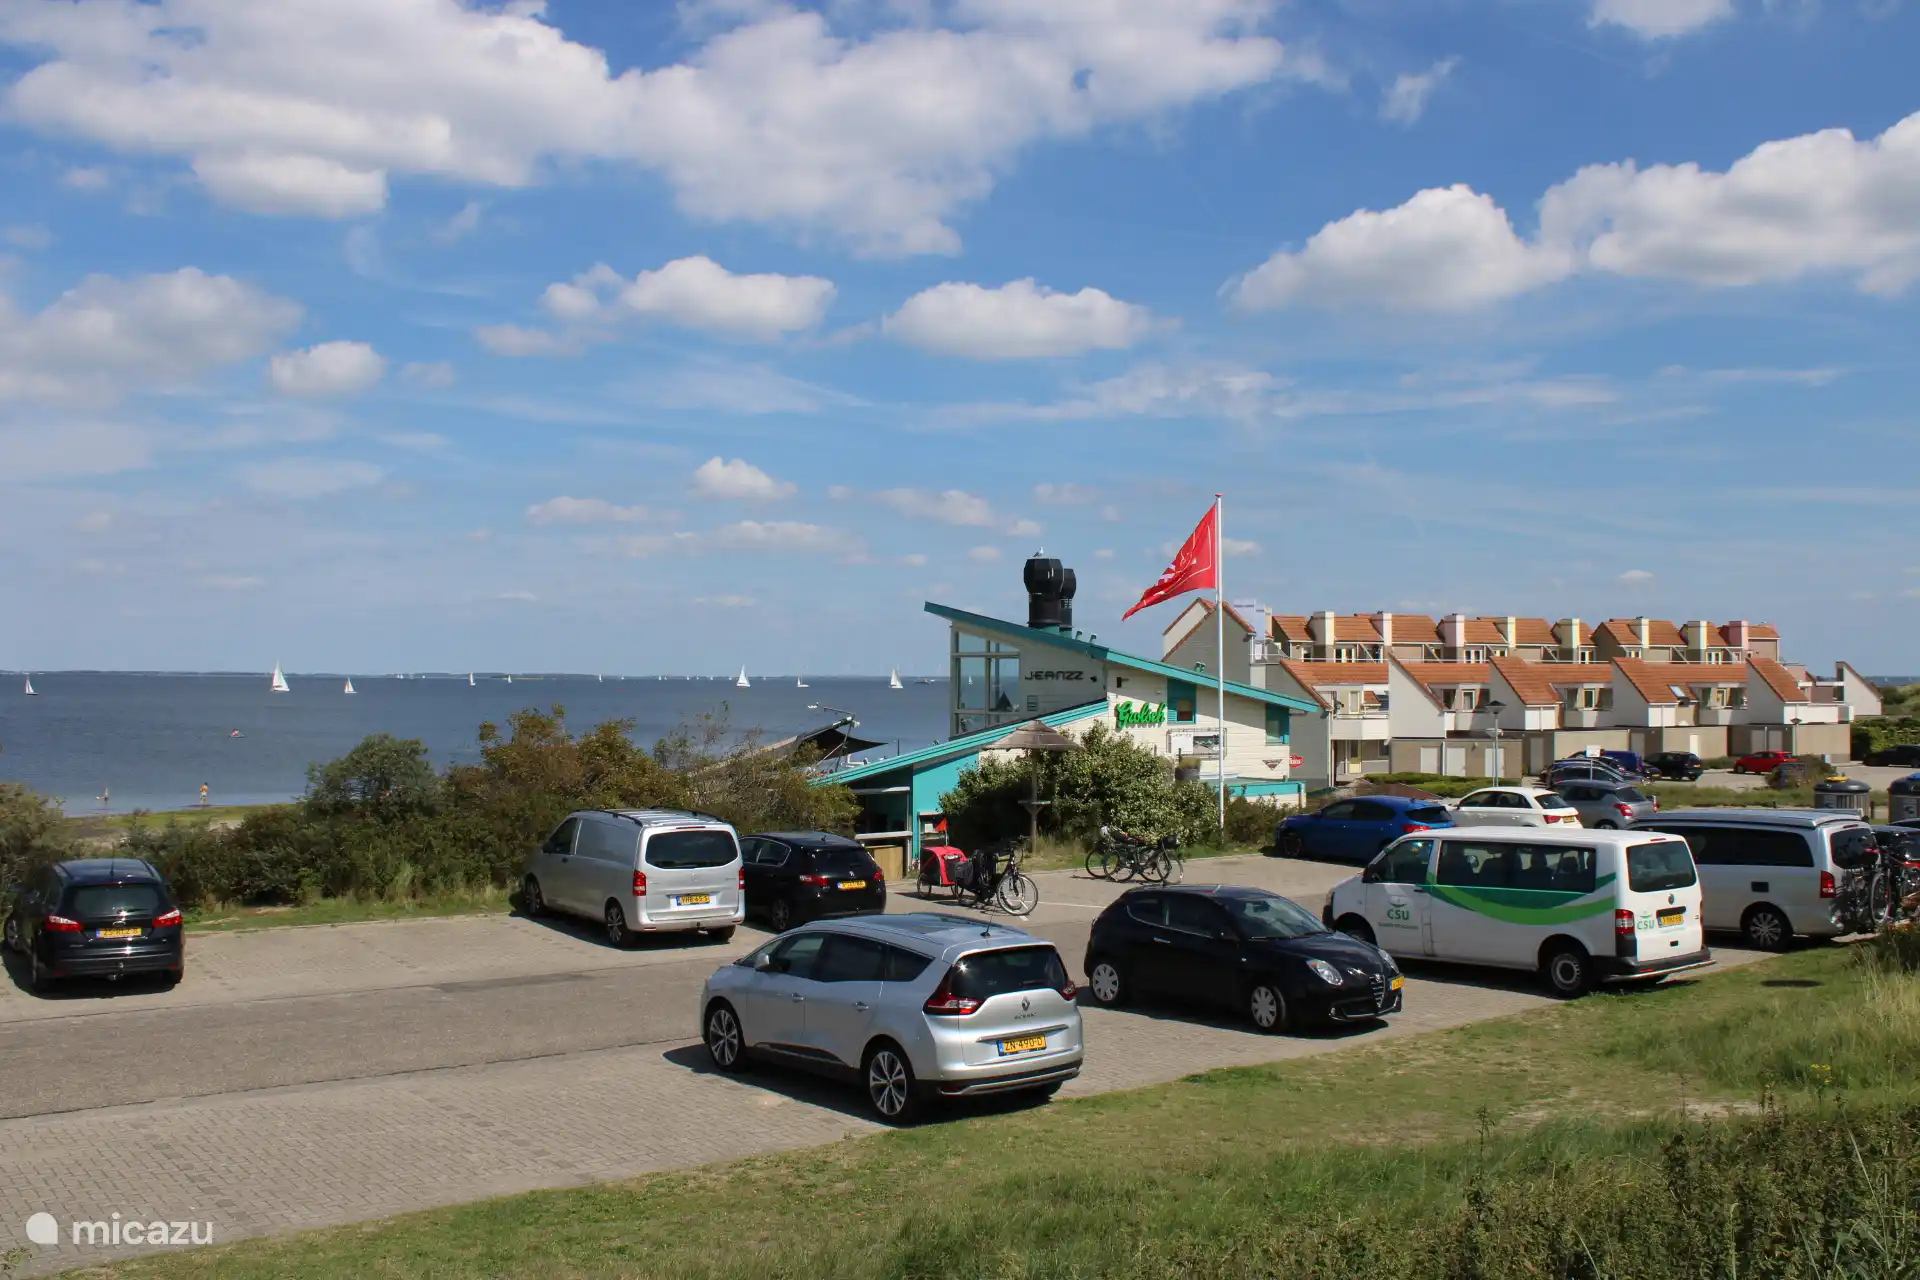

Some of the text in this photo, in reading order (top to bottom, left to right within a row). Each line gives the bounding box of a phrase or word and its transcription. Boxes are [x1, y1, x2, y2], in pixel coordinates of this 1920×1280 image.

[1025, 670, 1084, 681] JEANZZ
[1115, 700, 1166, 729] Grolsch
[1387, 909, 1410, 920] CSU
[1636, 919, 1655, 930] CSU
[1005, 1037, 1043, 1050] ZN-490-D
